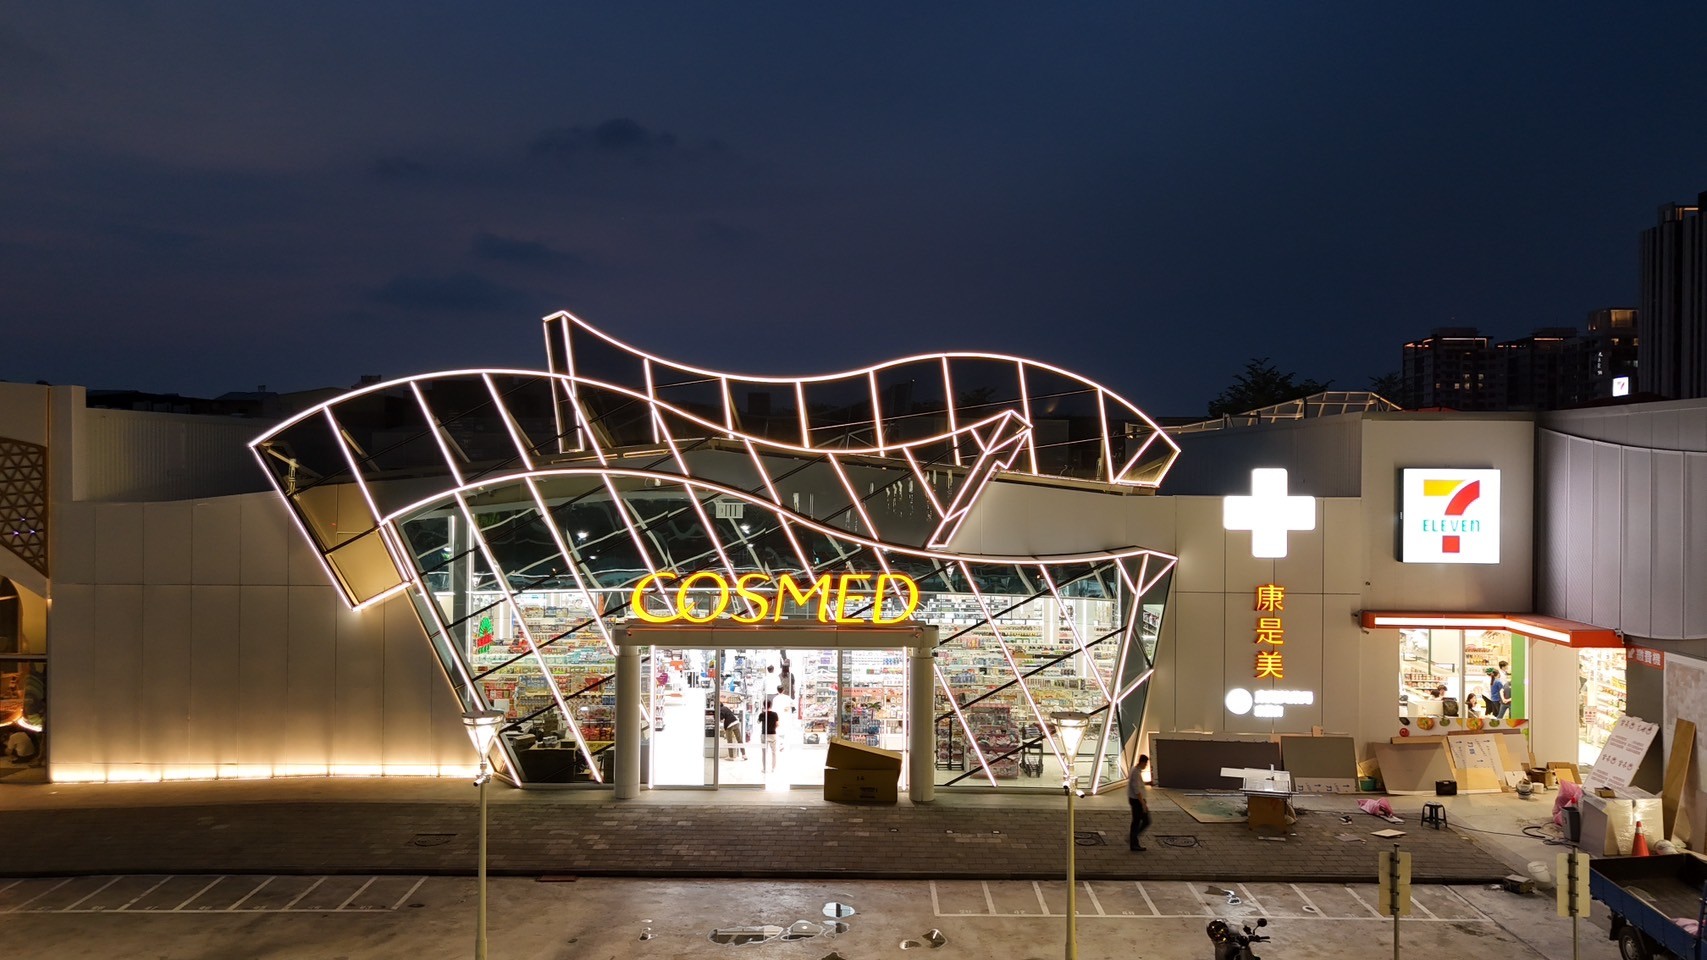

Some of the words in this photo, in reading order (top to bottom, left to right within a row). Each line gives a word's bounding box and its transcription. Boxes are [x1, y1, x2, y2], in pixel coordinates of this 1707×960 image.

[1423, 479, 1480, 553] 7
[631, 571, 919, 624] COSMED
[1256, 584, 1285, 679] 康是美
